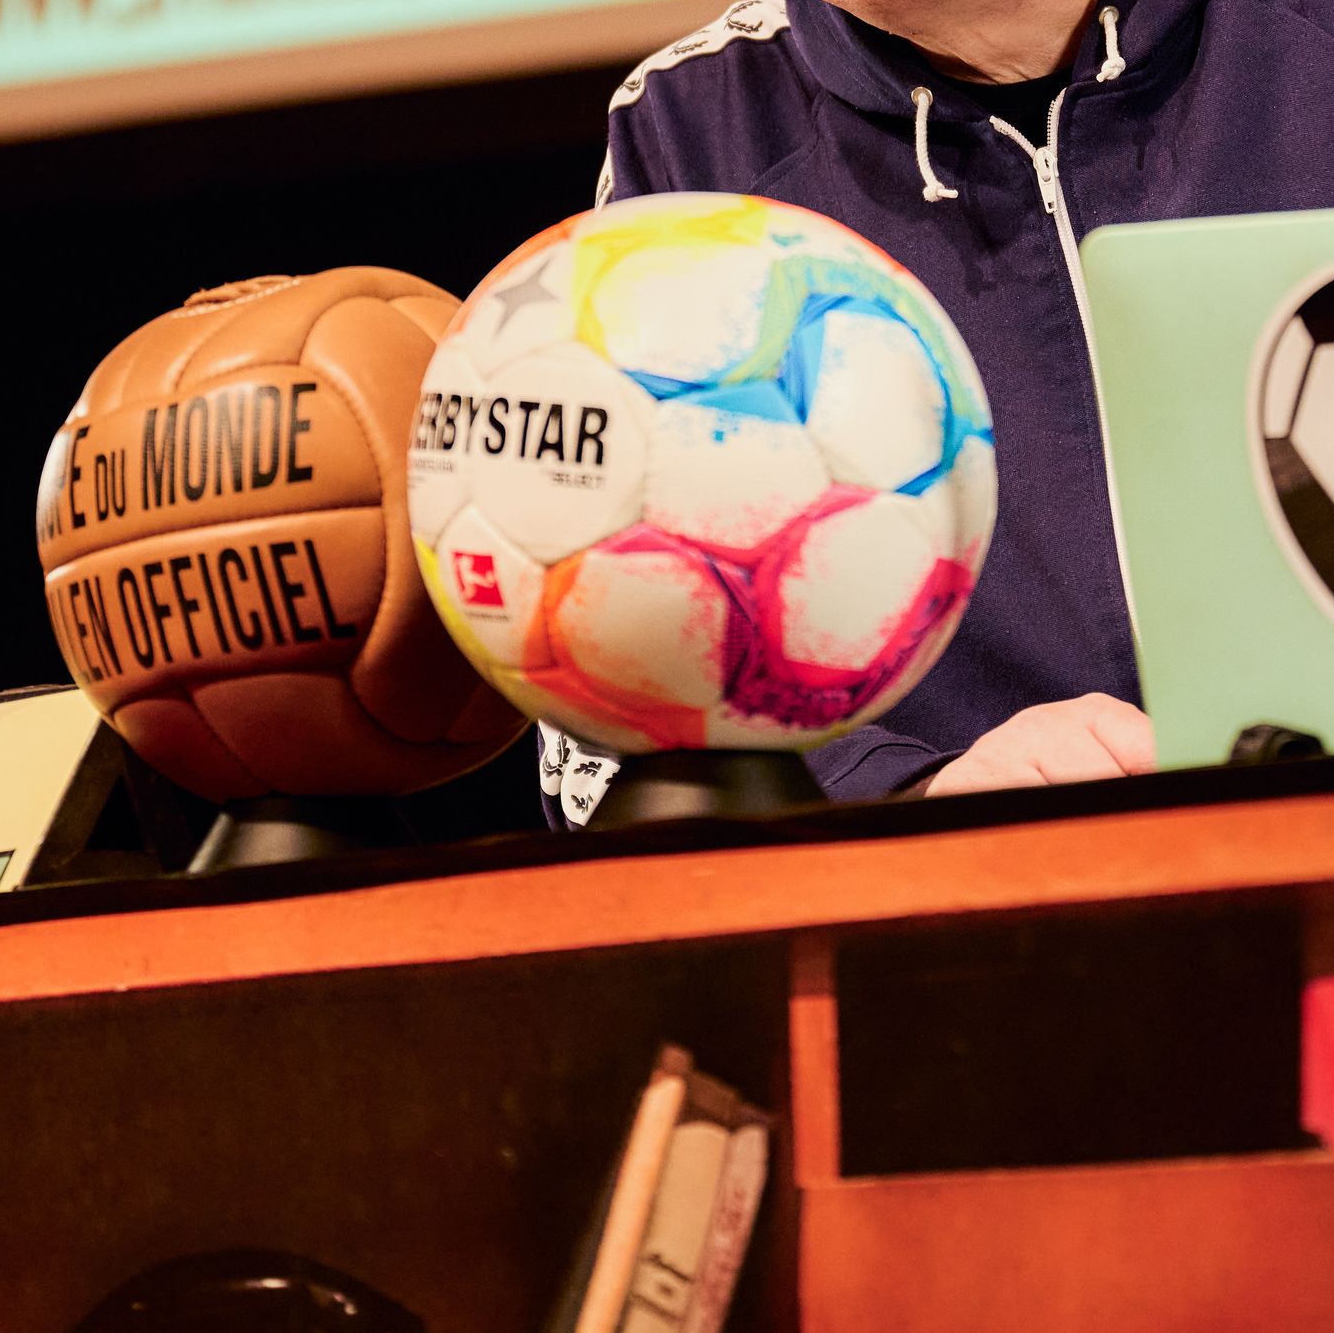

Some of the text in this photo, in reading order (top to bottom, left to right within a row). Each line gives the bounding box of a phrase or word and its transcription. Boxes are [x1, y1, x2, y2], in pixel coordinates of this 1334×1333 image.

[94, 449, 126, 522] DU
[141, 382, 317, 512] MONDE
[116, 538, 357, 666] OFFICIEL
